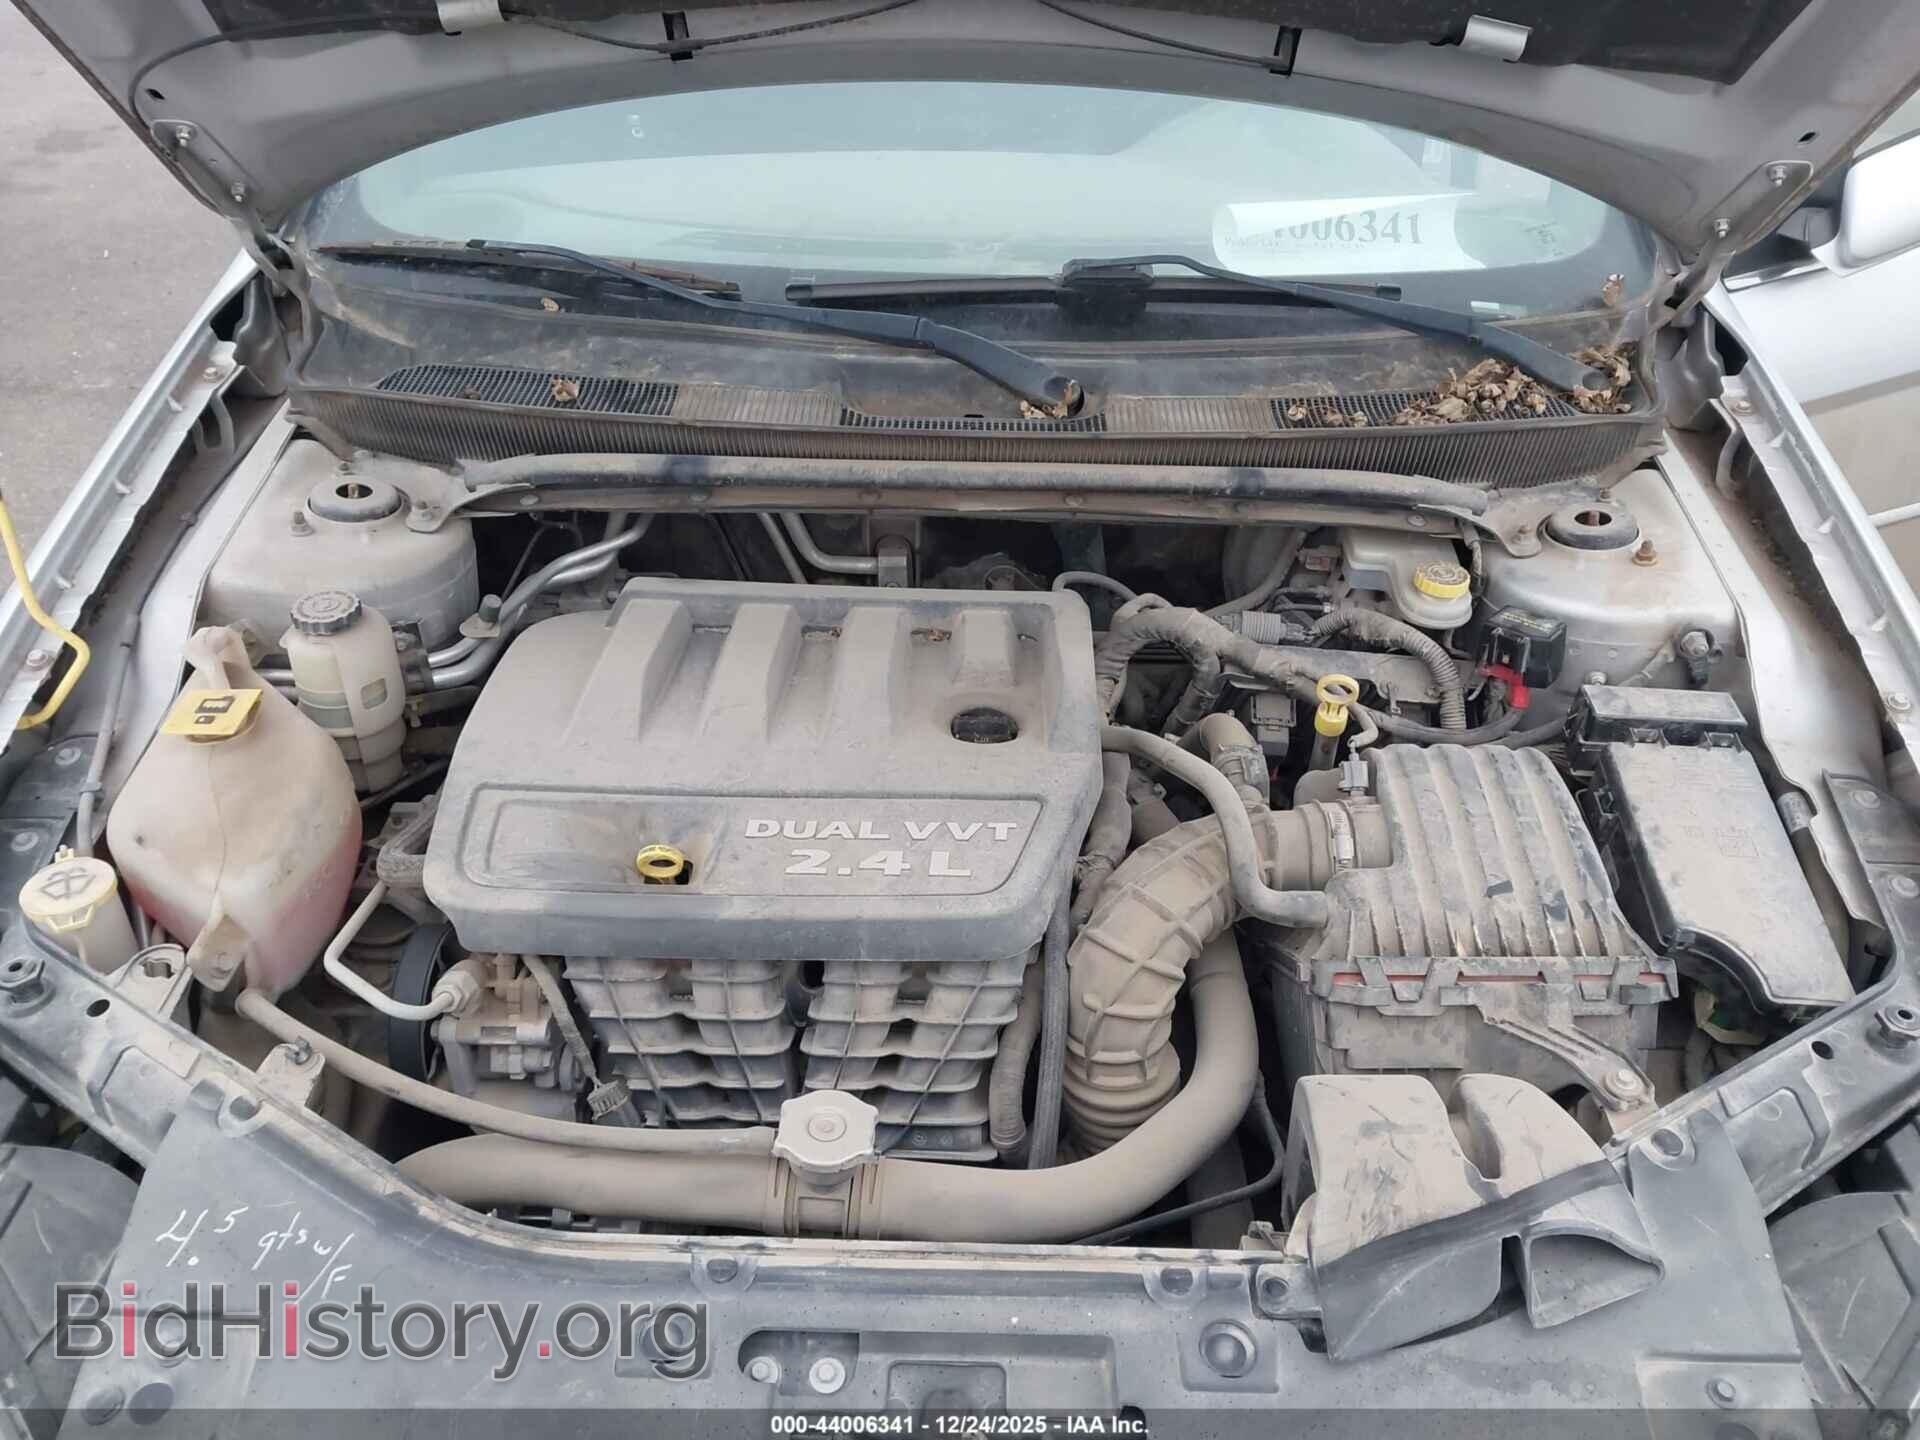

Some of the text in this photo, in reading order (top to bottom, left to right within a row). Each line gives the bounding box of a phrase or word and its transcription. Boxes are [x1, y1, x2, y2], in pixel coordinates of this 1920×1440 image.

[1274, 209, 1424, 244] 006341
[745, 819, 1018, 842] DUAL VVT
[785, 849, 973, 878] 2.4 L
